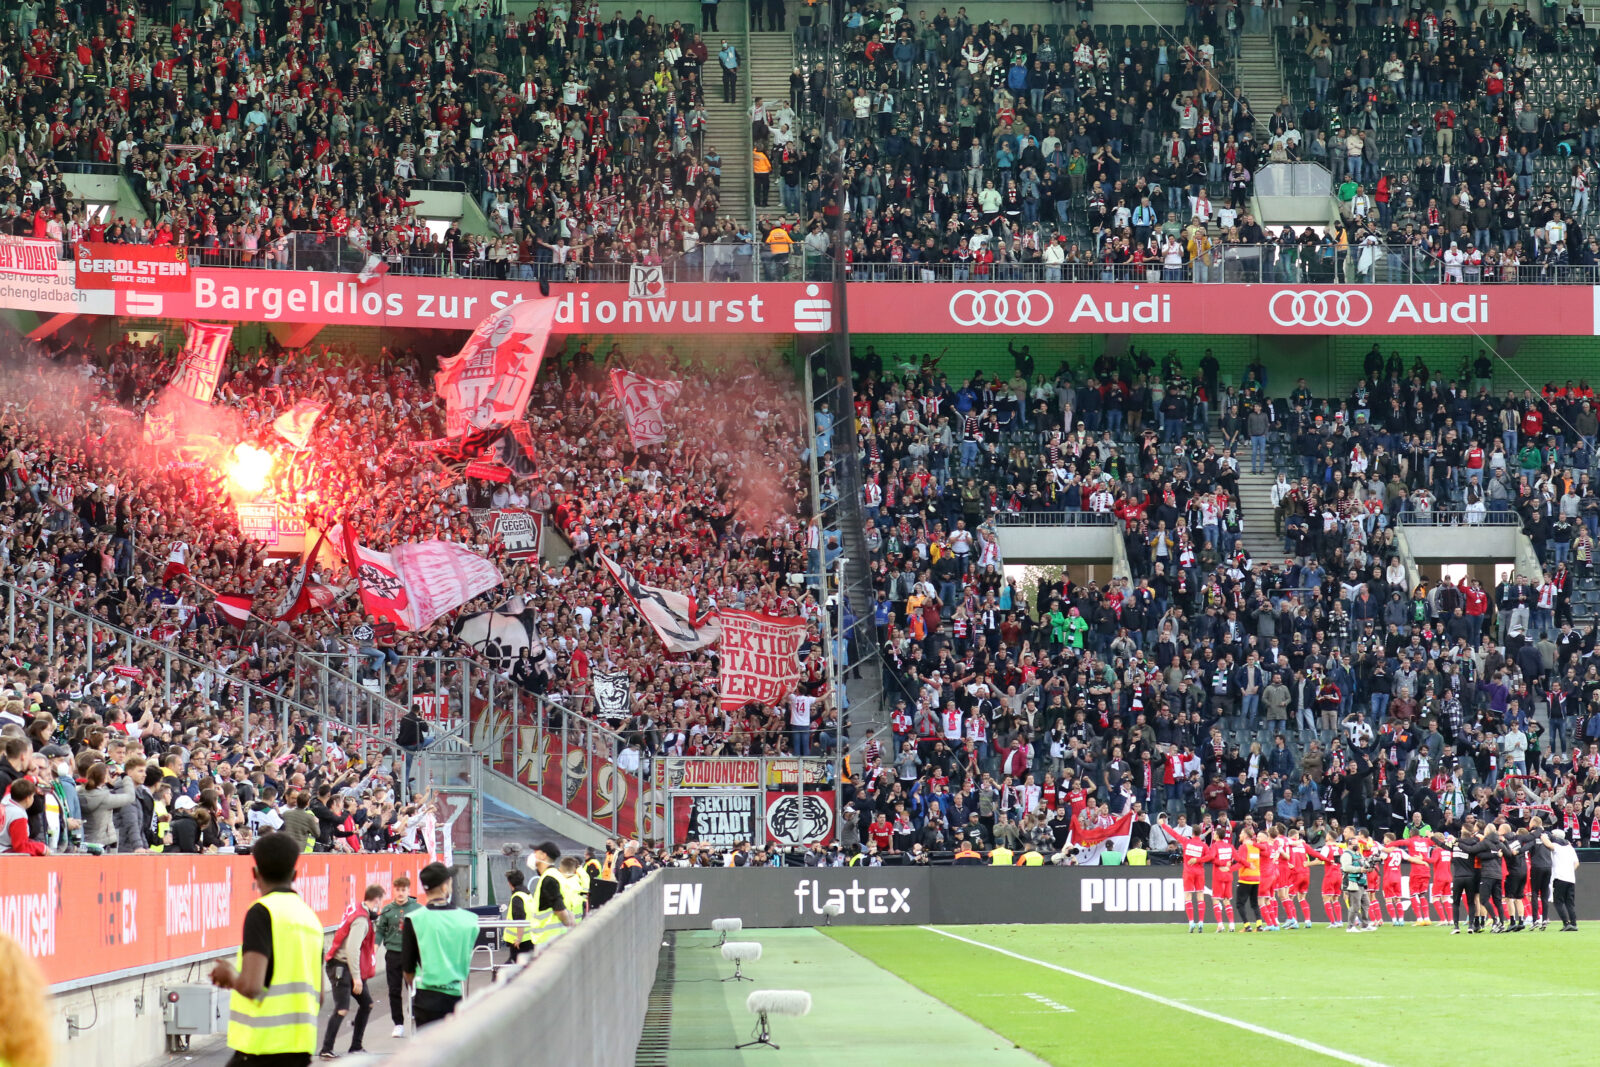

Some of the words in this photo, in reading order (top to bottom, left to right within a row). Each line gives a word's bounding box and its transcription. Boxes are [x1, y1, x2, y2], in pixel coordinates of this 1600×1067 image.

[15, 245, 58, 271] FIDELIS
[79, 258, 187, 276] GEROLSTEIN
[111, 275, 135, 283] SINCE
[136, 276, 156, 284] 2012
[195, 277, 404, 319] Bargeldlos
[416, 294, 478, 319] zur
[490, 290, 764, 324] Sdionwurst
[1068, 293, 1171, 323] Audi
[1387, 294, 1489, 323] Audi
[502, 520, 531, 531] GEGEN
[170, 541, 183, 553] 12
[796, 702, 806, 713] 14
[696, 796, 751, 812] SEKTION
[696, 812, 751, 834] STADT
[1388, 852, 1402, 867] 29
[165, 868, 192, 936] Invest
[663, 883, 703, 916] EN
[1081, 878, 1186, 912] PUMA
